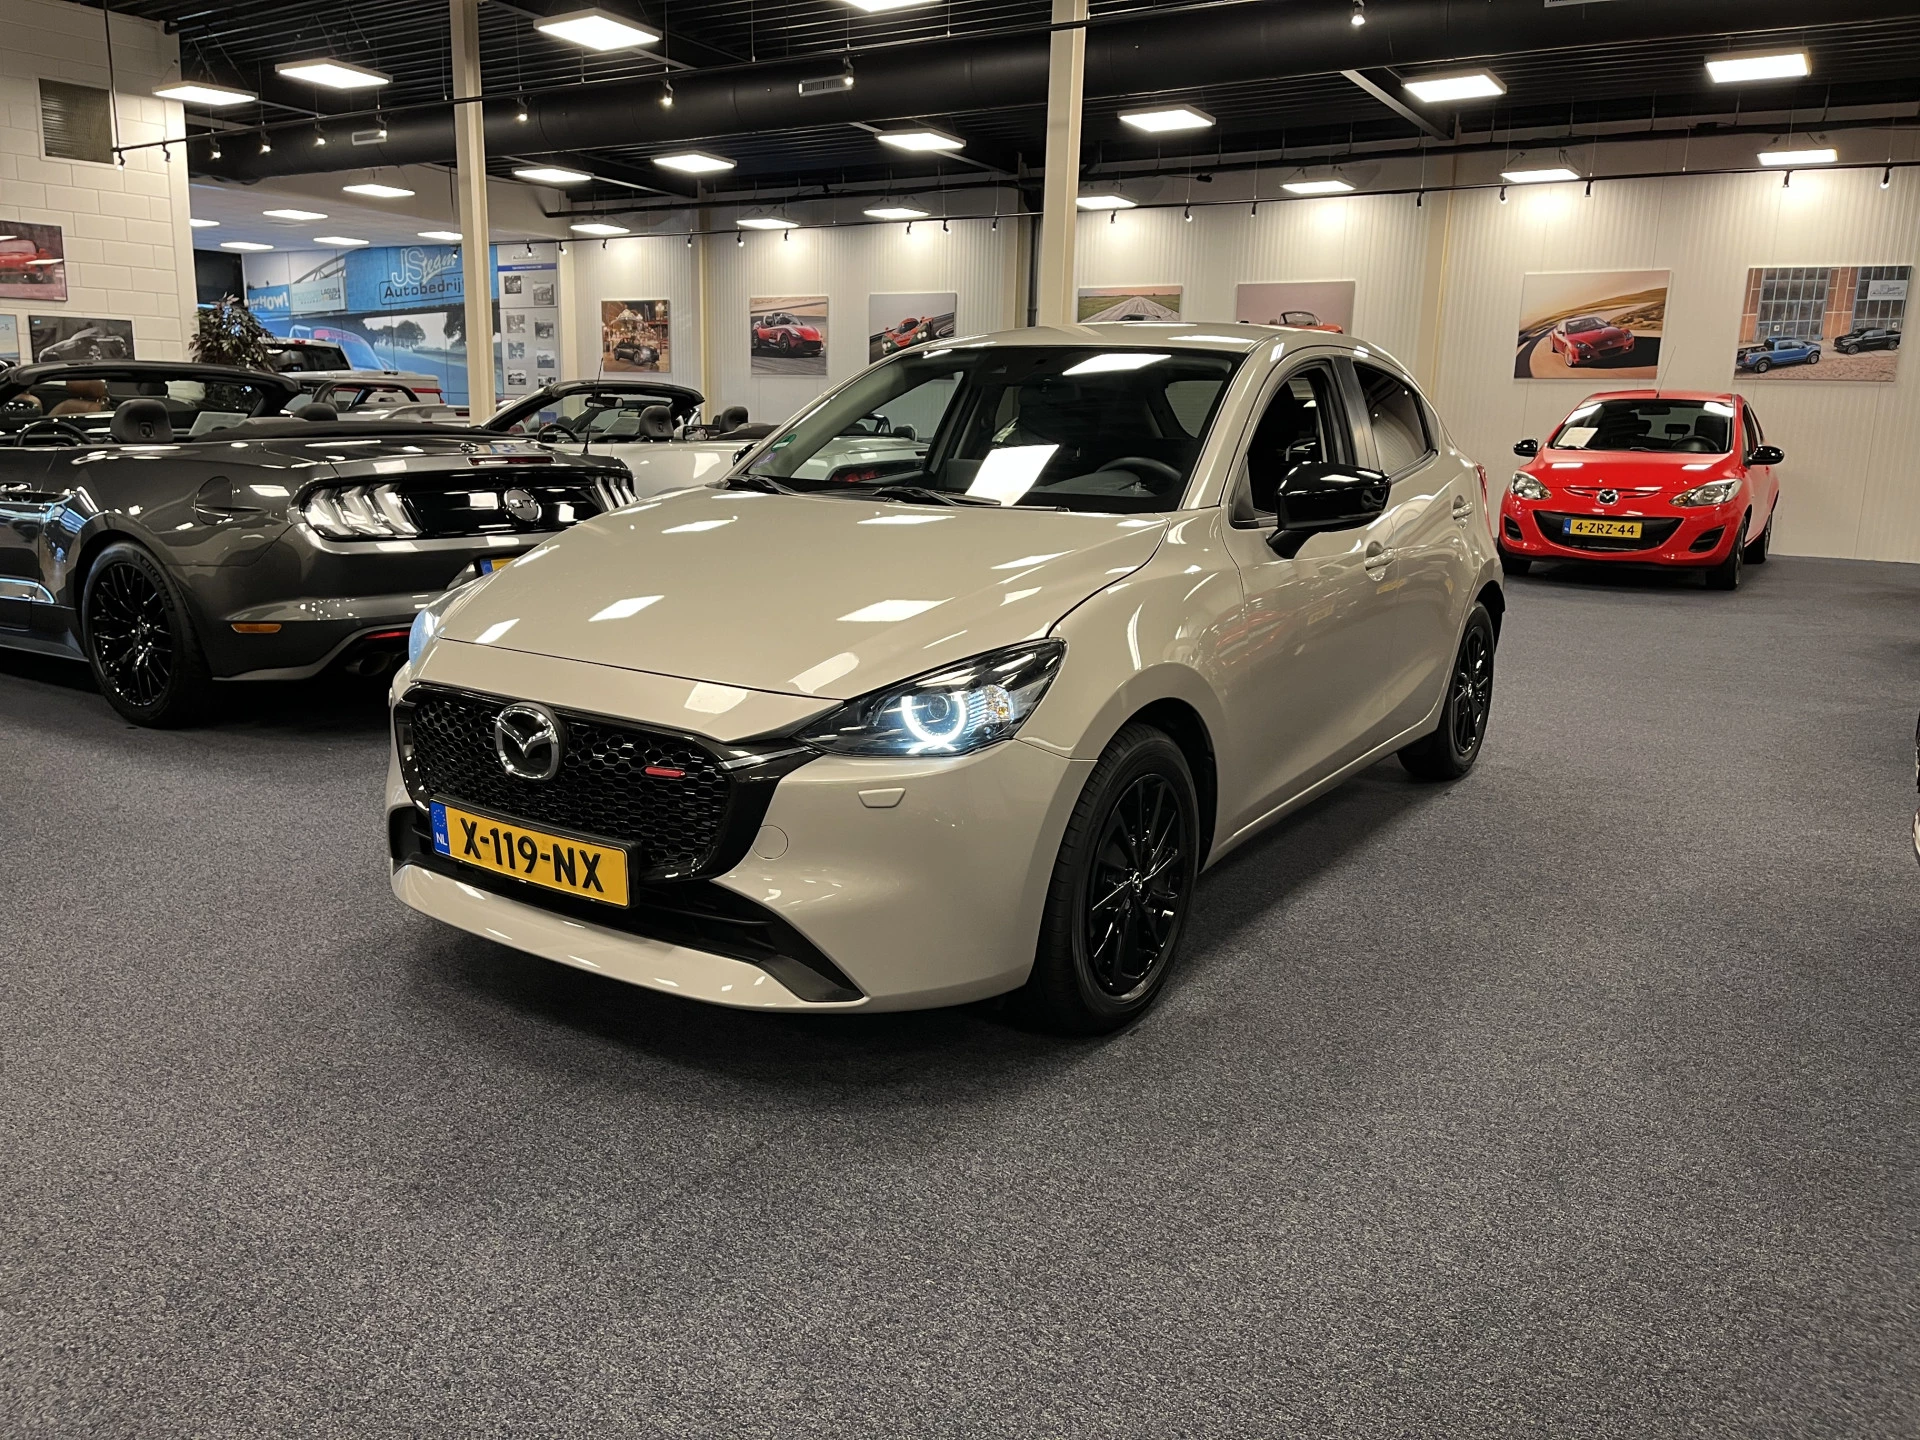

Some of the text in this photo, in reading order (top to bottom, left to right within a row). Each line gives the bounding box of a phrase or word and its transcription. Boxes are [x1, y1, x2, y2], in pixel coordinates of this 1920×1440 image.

[1575, 522, 1634, 535] 4-ZRZ-44
[436, 832, 448, 846] NL
[460, 817, 605, 893] X-119-NX
